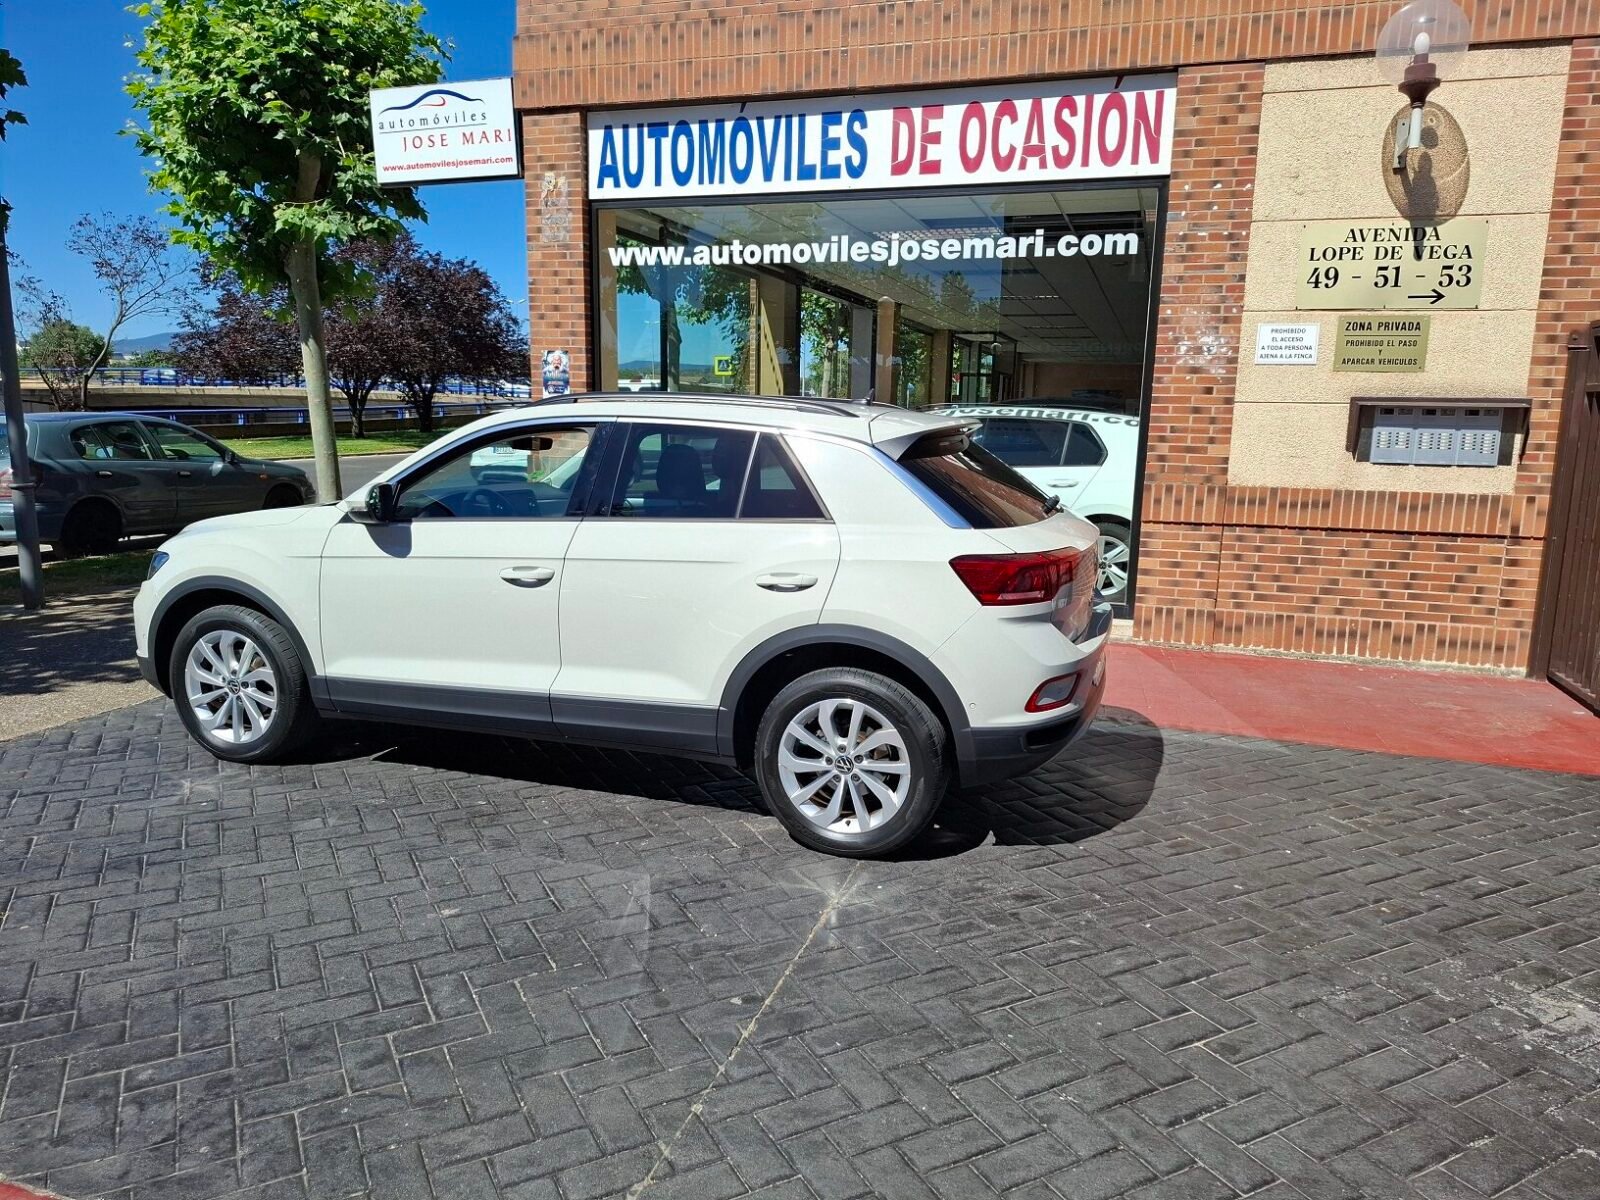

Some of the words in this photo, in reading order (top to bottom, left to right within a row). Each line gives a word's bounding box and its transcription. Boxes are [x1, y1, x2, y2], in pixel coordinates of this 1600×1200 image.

[379, 111, 487, 130] automóviles
[403, 133, 449, 152] JOSE
[462, 128, 512, 145] MARI
[597, 102, 868, 189] AUTOMÓVILES
[890, 104, 944, 176] DE
[959, 75, 1165, 174] OCASIÓN
[382, 156, 513, 172] www.automovilesjosemari.com
[1344, 226, 1441, 243] AVENIDA
[608, 229, 1139, 267] www.automovilesjosemari.com
[1308, 246, 1364, 262] LOPE
[1374, 246, 1403, 261] DE
[1413, 244, 1473, 261] VEGA
[1306, 266, 1340, 289] 49
[1373, 265, 1402, 288] 51
[1438, 264, 1473, 288] 53
[1345, 322, 1372, 332] ZONA
[1377, 321, 1421, 332] PRIVADA
[1341, 358, 1375, 366] APARCAR
[1378, 358, 1418, 366] VEHICULOS
